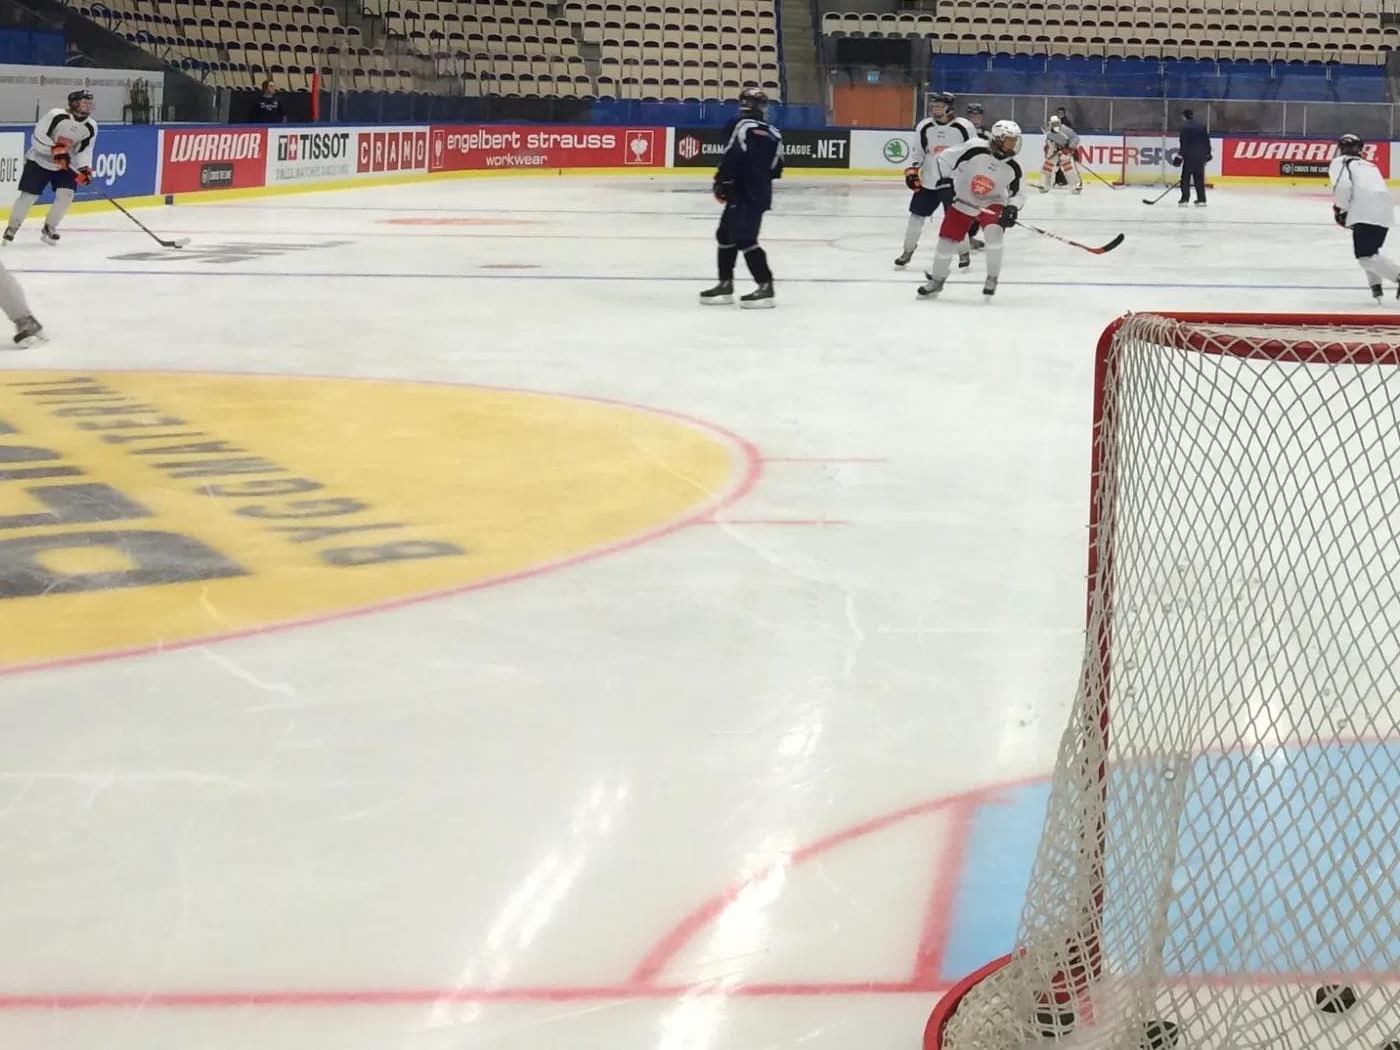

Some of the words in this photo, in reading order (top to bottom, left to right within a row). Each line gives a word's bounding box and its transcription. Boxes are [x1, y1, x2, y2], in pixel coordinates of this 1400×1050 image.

[170, 134, 261, 162] WARRIOR
[301, 133, 349, 159] TISSOT
[359, 137, 425, 166] CRAMO
[447, 130, 520, 153] engelbert
[527, 131, 616, 149] strauss
[1234, 141, 1378, 161] WARRIR
[485, 153, 548, 166] workwear
